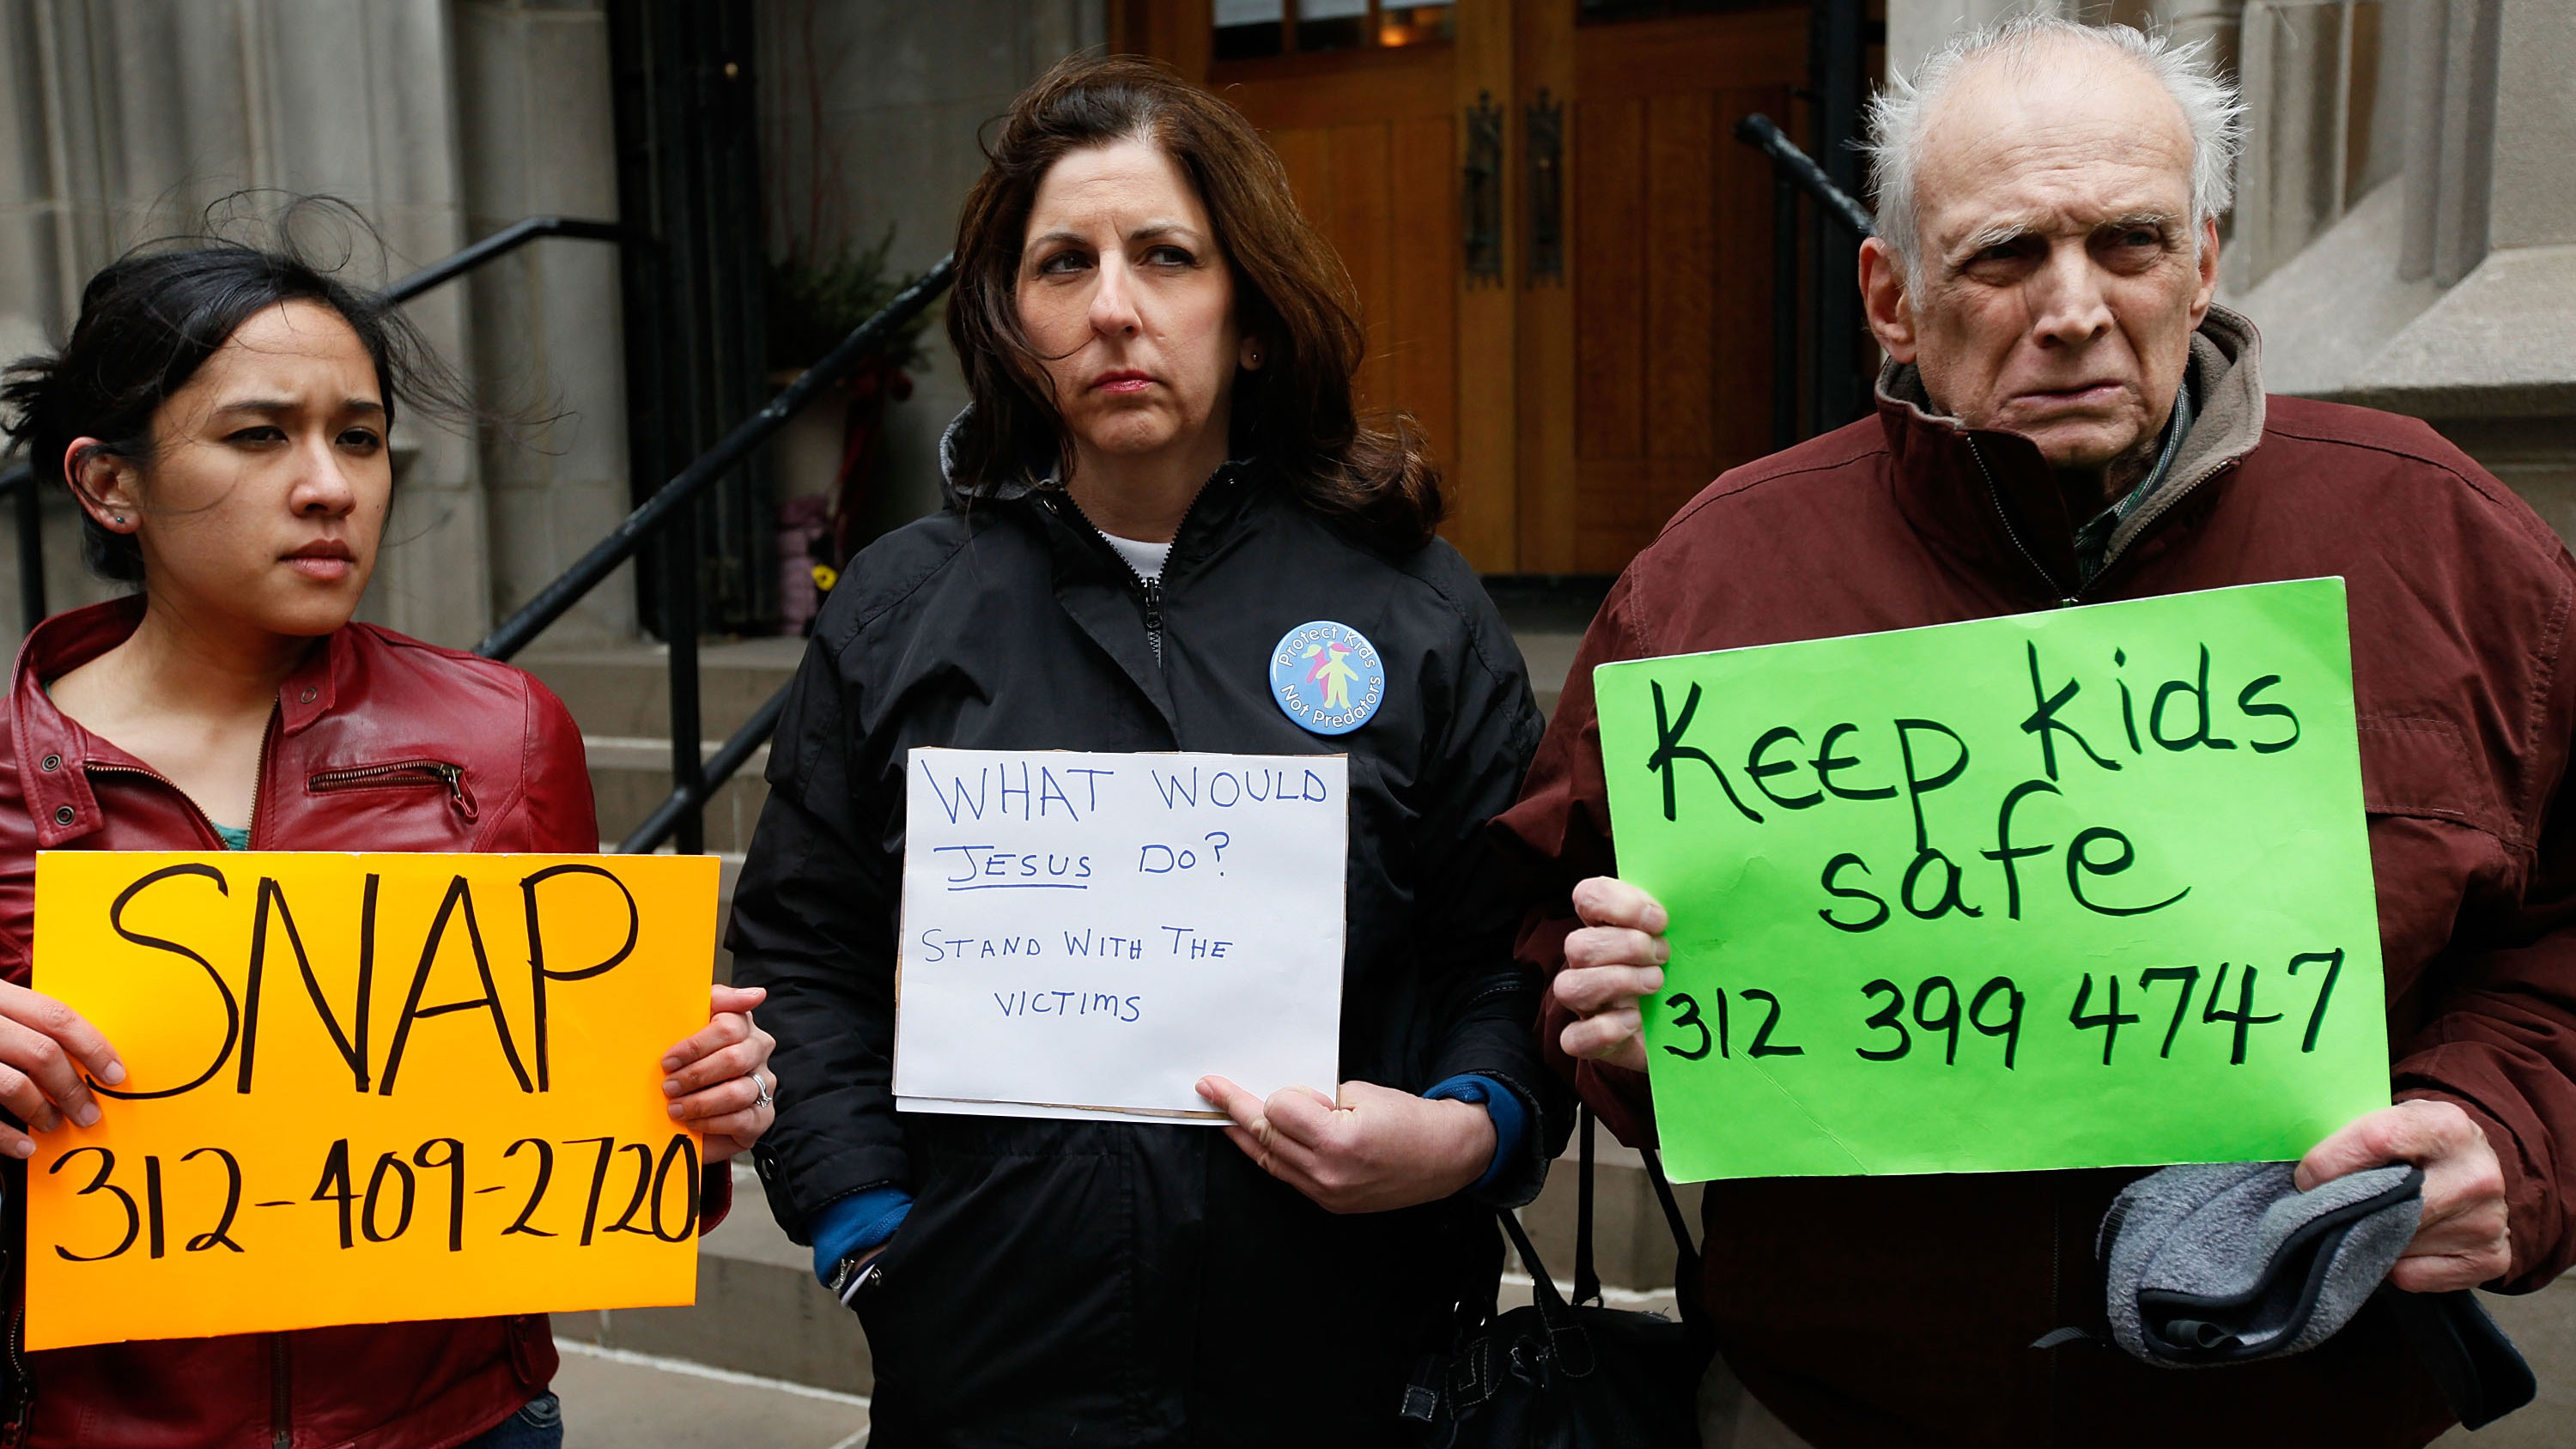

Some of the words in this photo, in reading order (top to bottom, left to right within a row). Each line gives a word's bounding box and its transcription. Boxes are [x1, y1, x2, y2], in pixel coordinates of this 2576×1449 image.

[1278, 626, 1338, 667] Protect
[1343, 630, 1376, 668] Kids
[1280, 684, 1310, 717] Not
[1312, 676, 1382, 728] Predators
[921, 759, 1115, 824] WHAT
[1151, 767, 1327, 809] WOULD
[933, 845, 1092, 882] JESUS
[1818, 778, 2192, 933] safe
[921, 928, 1041, 962] STAND
[1064, 928, 1142, 961] WITH
[1161, 925, 1234, 960] THE
[86, 863, 639, 1100] SNAP
[993, 990, 1141, 1022] VICTIMS
[1663, 987, 1805, 1061] 312
[1856, 975, 2026, 1070] 399
[2069, 947, 2344, 1066] 4747
[48, 1132, 700, 1262] 312-409-2720
